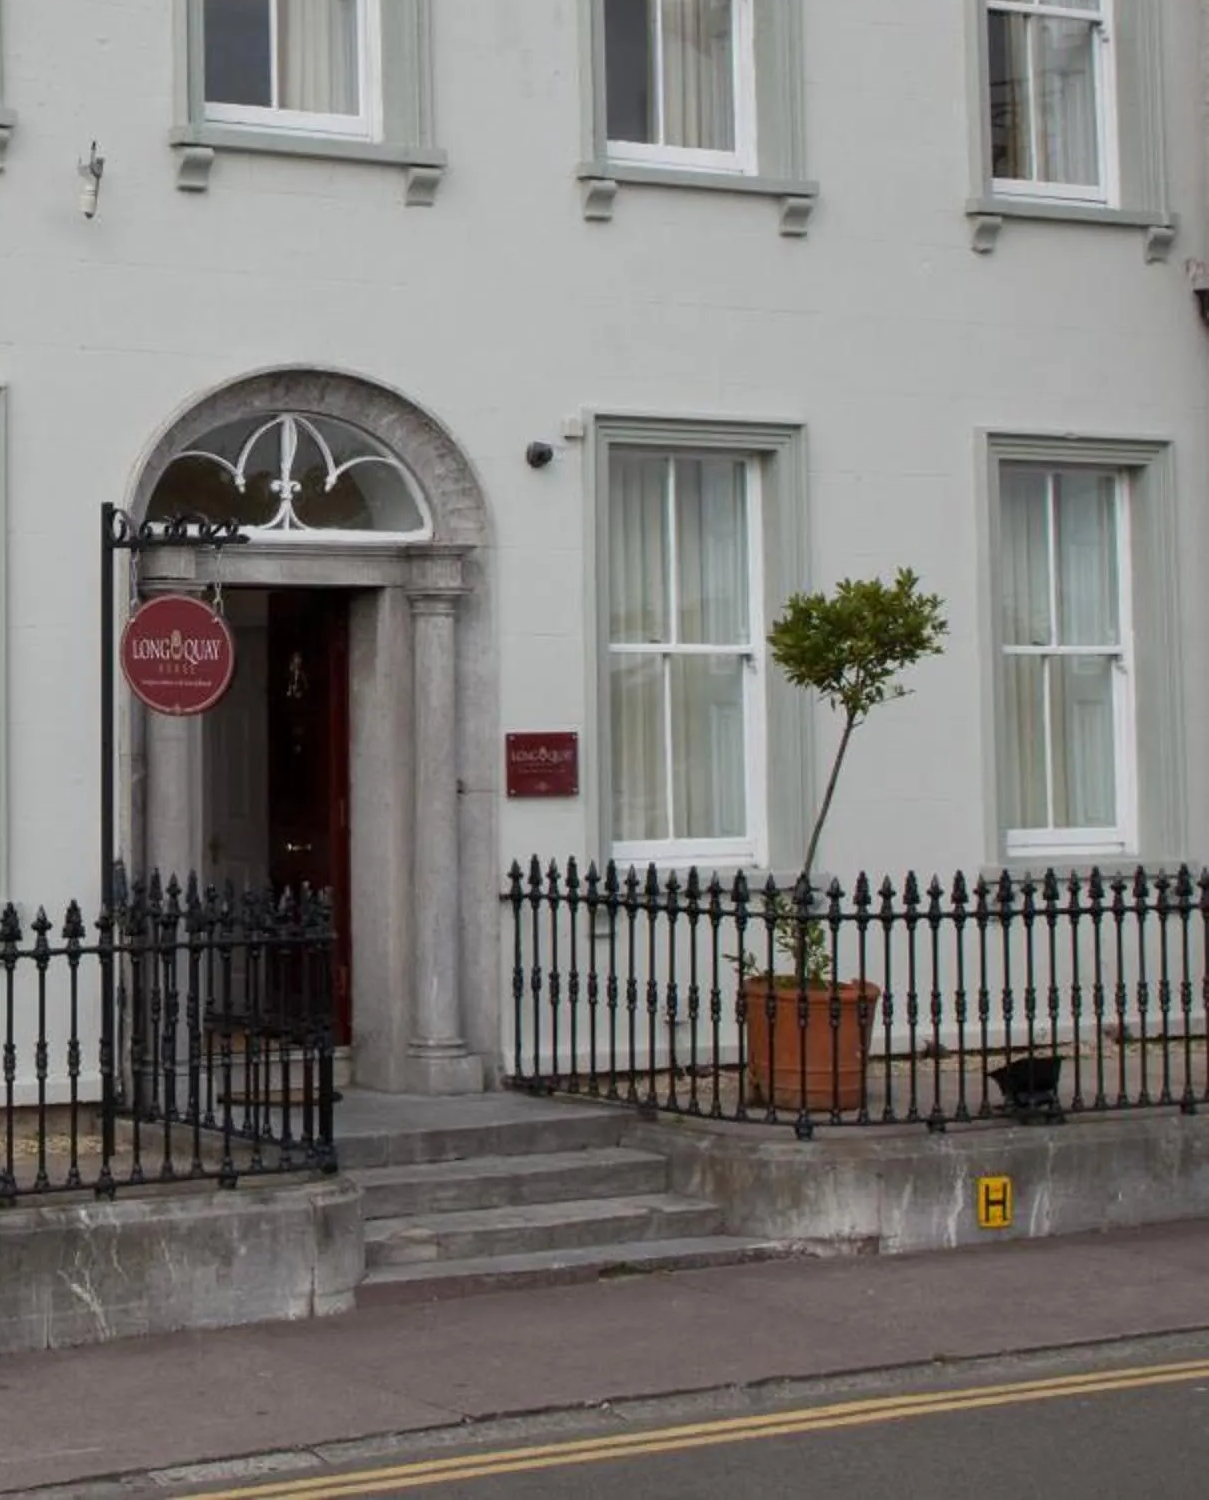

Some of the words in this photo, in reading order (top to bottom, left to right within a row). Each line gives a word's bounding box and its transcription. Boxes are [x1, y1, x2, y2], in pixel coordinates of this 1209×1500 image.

[132, 638, 170, 660] LONG
[184, 638, 222, 665] QUAY
[984, 1183, 1008, 1223] H
